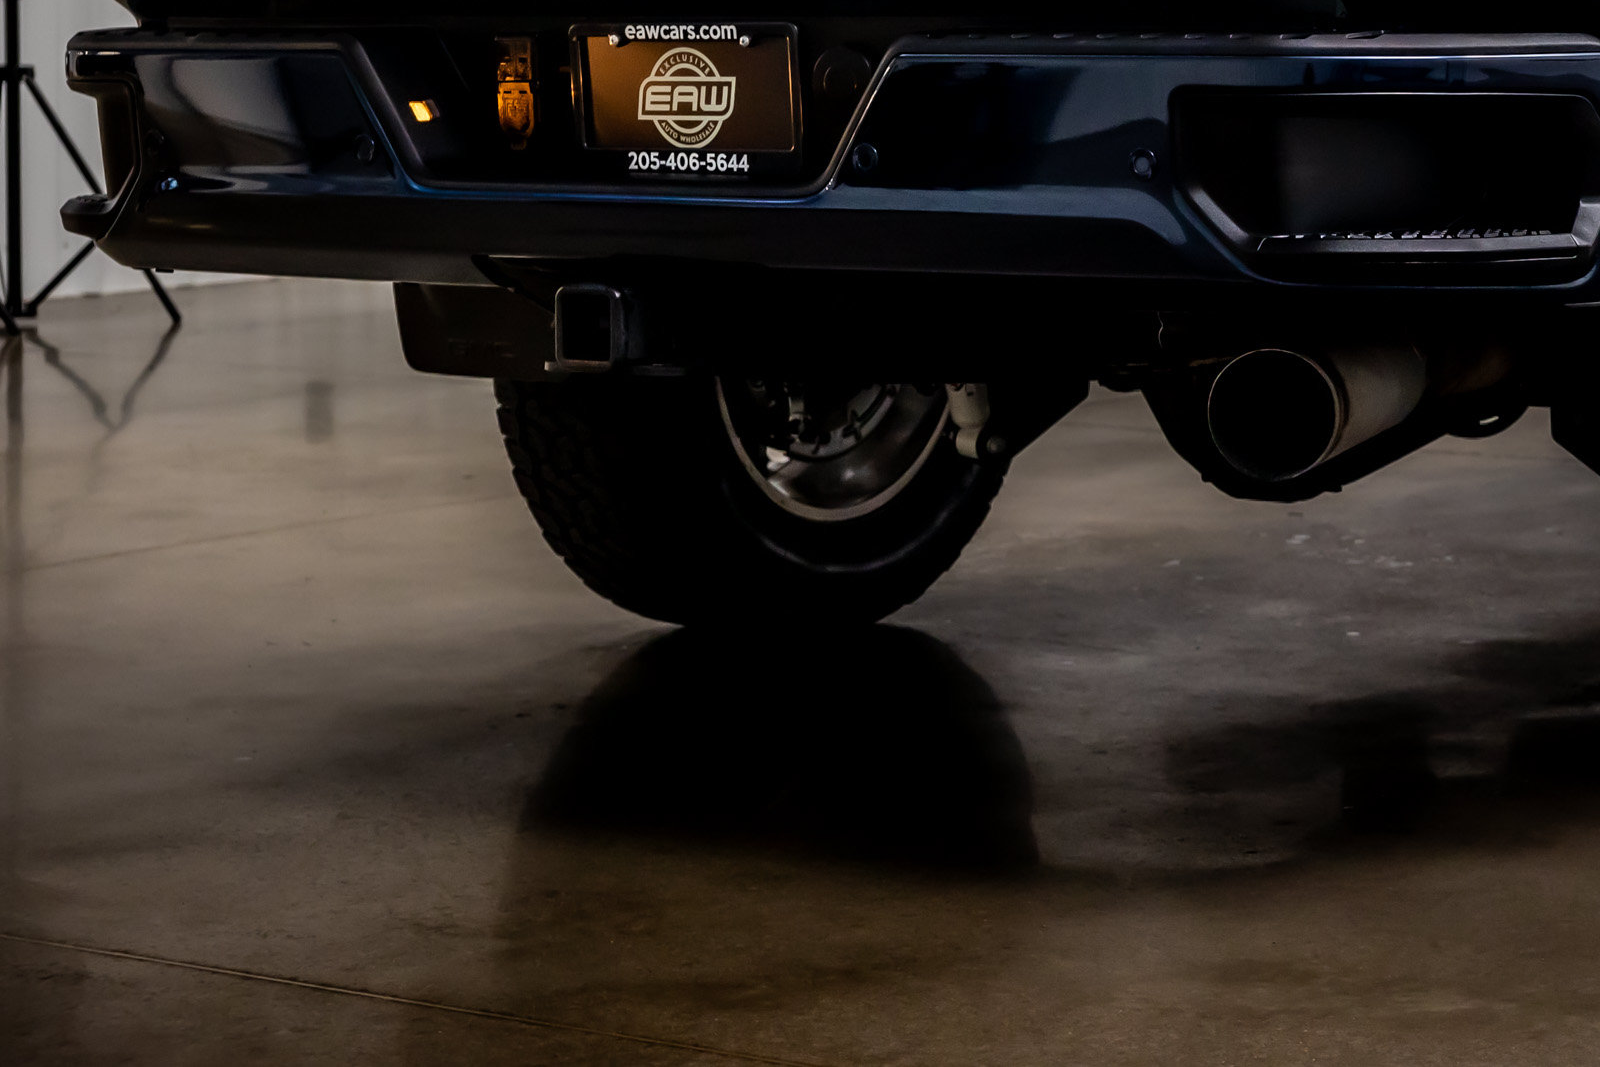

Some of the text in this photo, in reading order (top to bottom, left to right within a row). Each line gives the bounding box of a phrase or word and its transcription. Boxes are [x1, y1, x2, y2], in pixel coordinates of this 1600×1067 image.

[624, 24, 738, 40] eawcars.com
[659, 54, 710, 75] EXCLUSIVE
[645, 85, 728, 111] EAW
[661, 121, 716, 143] AUTO WHOLESALE
[628, 151, 750, 172] 205-406-5644
